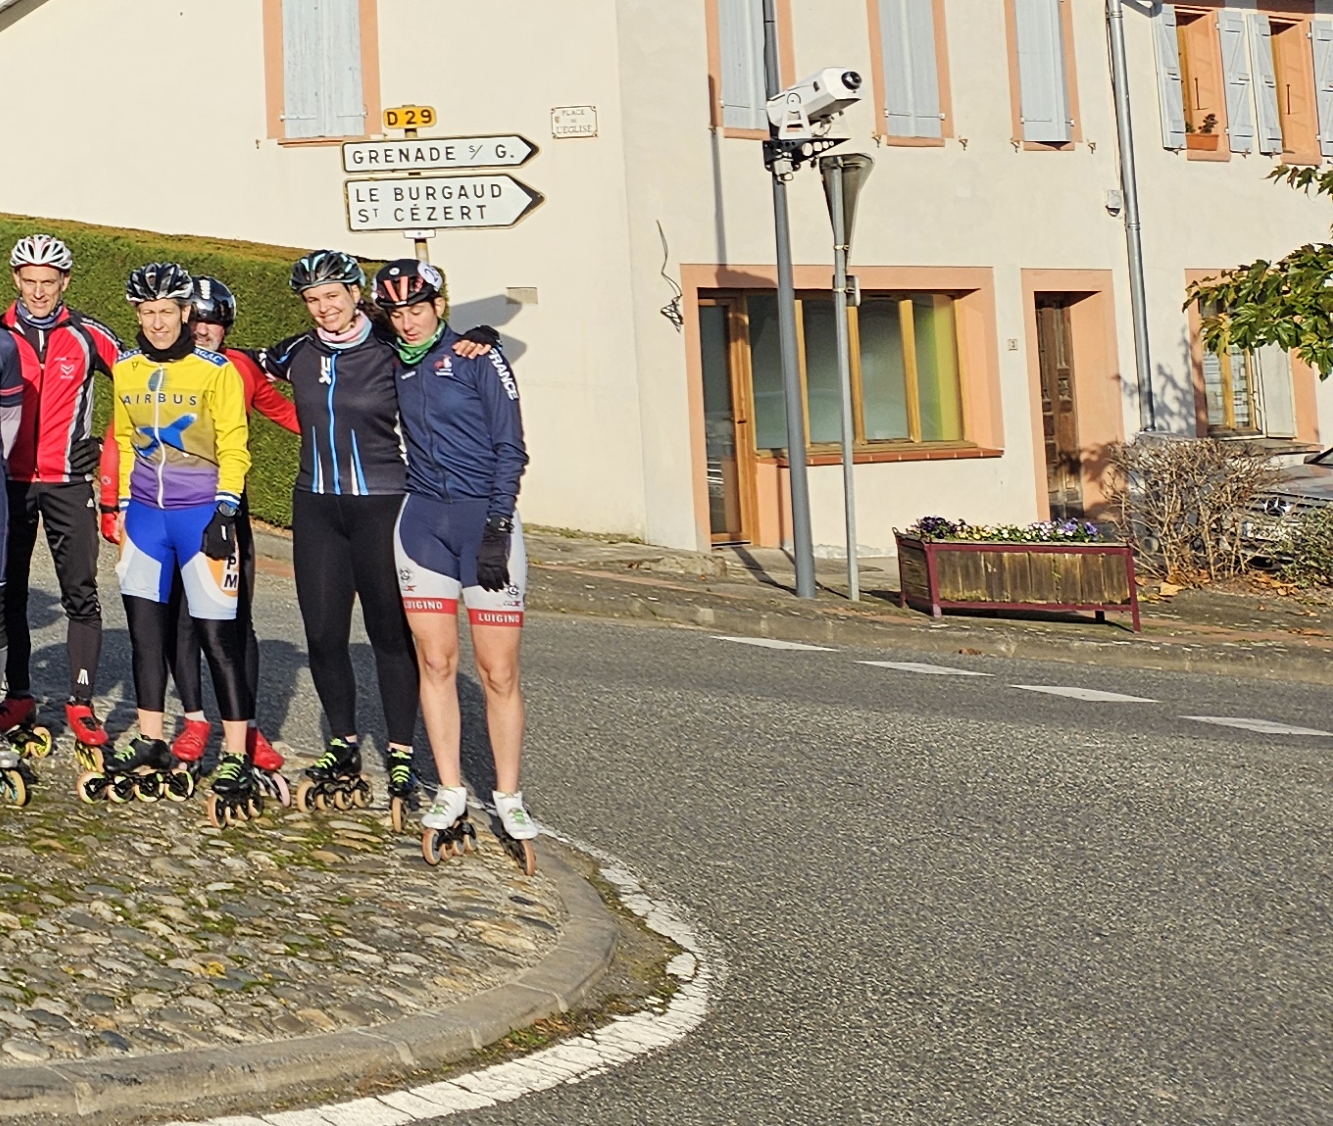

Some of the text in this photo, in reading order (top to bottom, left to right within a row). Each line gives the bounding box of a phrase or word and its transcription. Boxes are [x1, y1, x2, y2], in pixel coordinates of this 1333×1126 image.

[387, 110, 432, 126] D 29
[353, 146, 456, 165] GRENADE
[495, 144, 515, 159] G.
[356, 184, 502, 203] LE BURGAUD
[394, 204, 487, 222] CÉZERT
[489, 348, 519, 401] FRANCE
[124, 393, 197, 406] AIRBUS
[478, 612, 521, 624] LUIGINO
